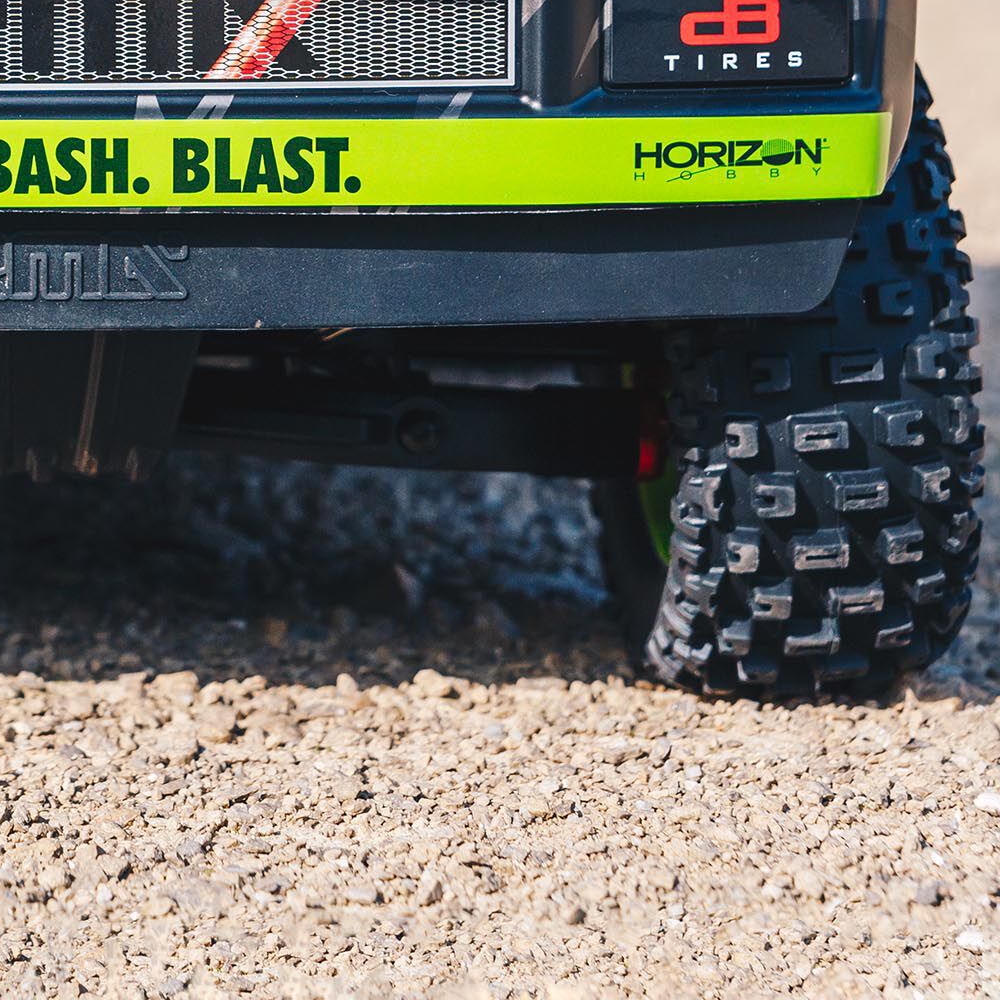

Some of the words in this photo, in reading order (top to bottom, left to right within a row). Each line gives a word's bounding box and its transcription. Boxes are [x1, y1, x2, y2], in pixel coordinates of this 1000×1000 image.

[664, 51, 803, 71] TIRES
[173, 137, 361, 194] BLAST.
[634, 138, 822, 168] HORIZON
[634, 167, 821, 181] HOBBY
